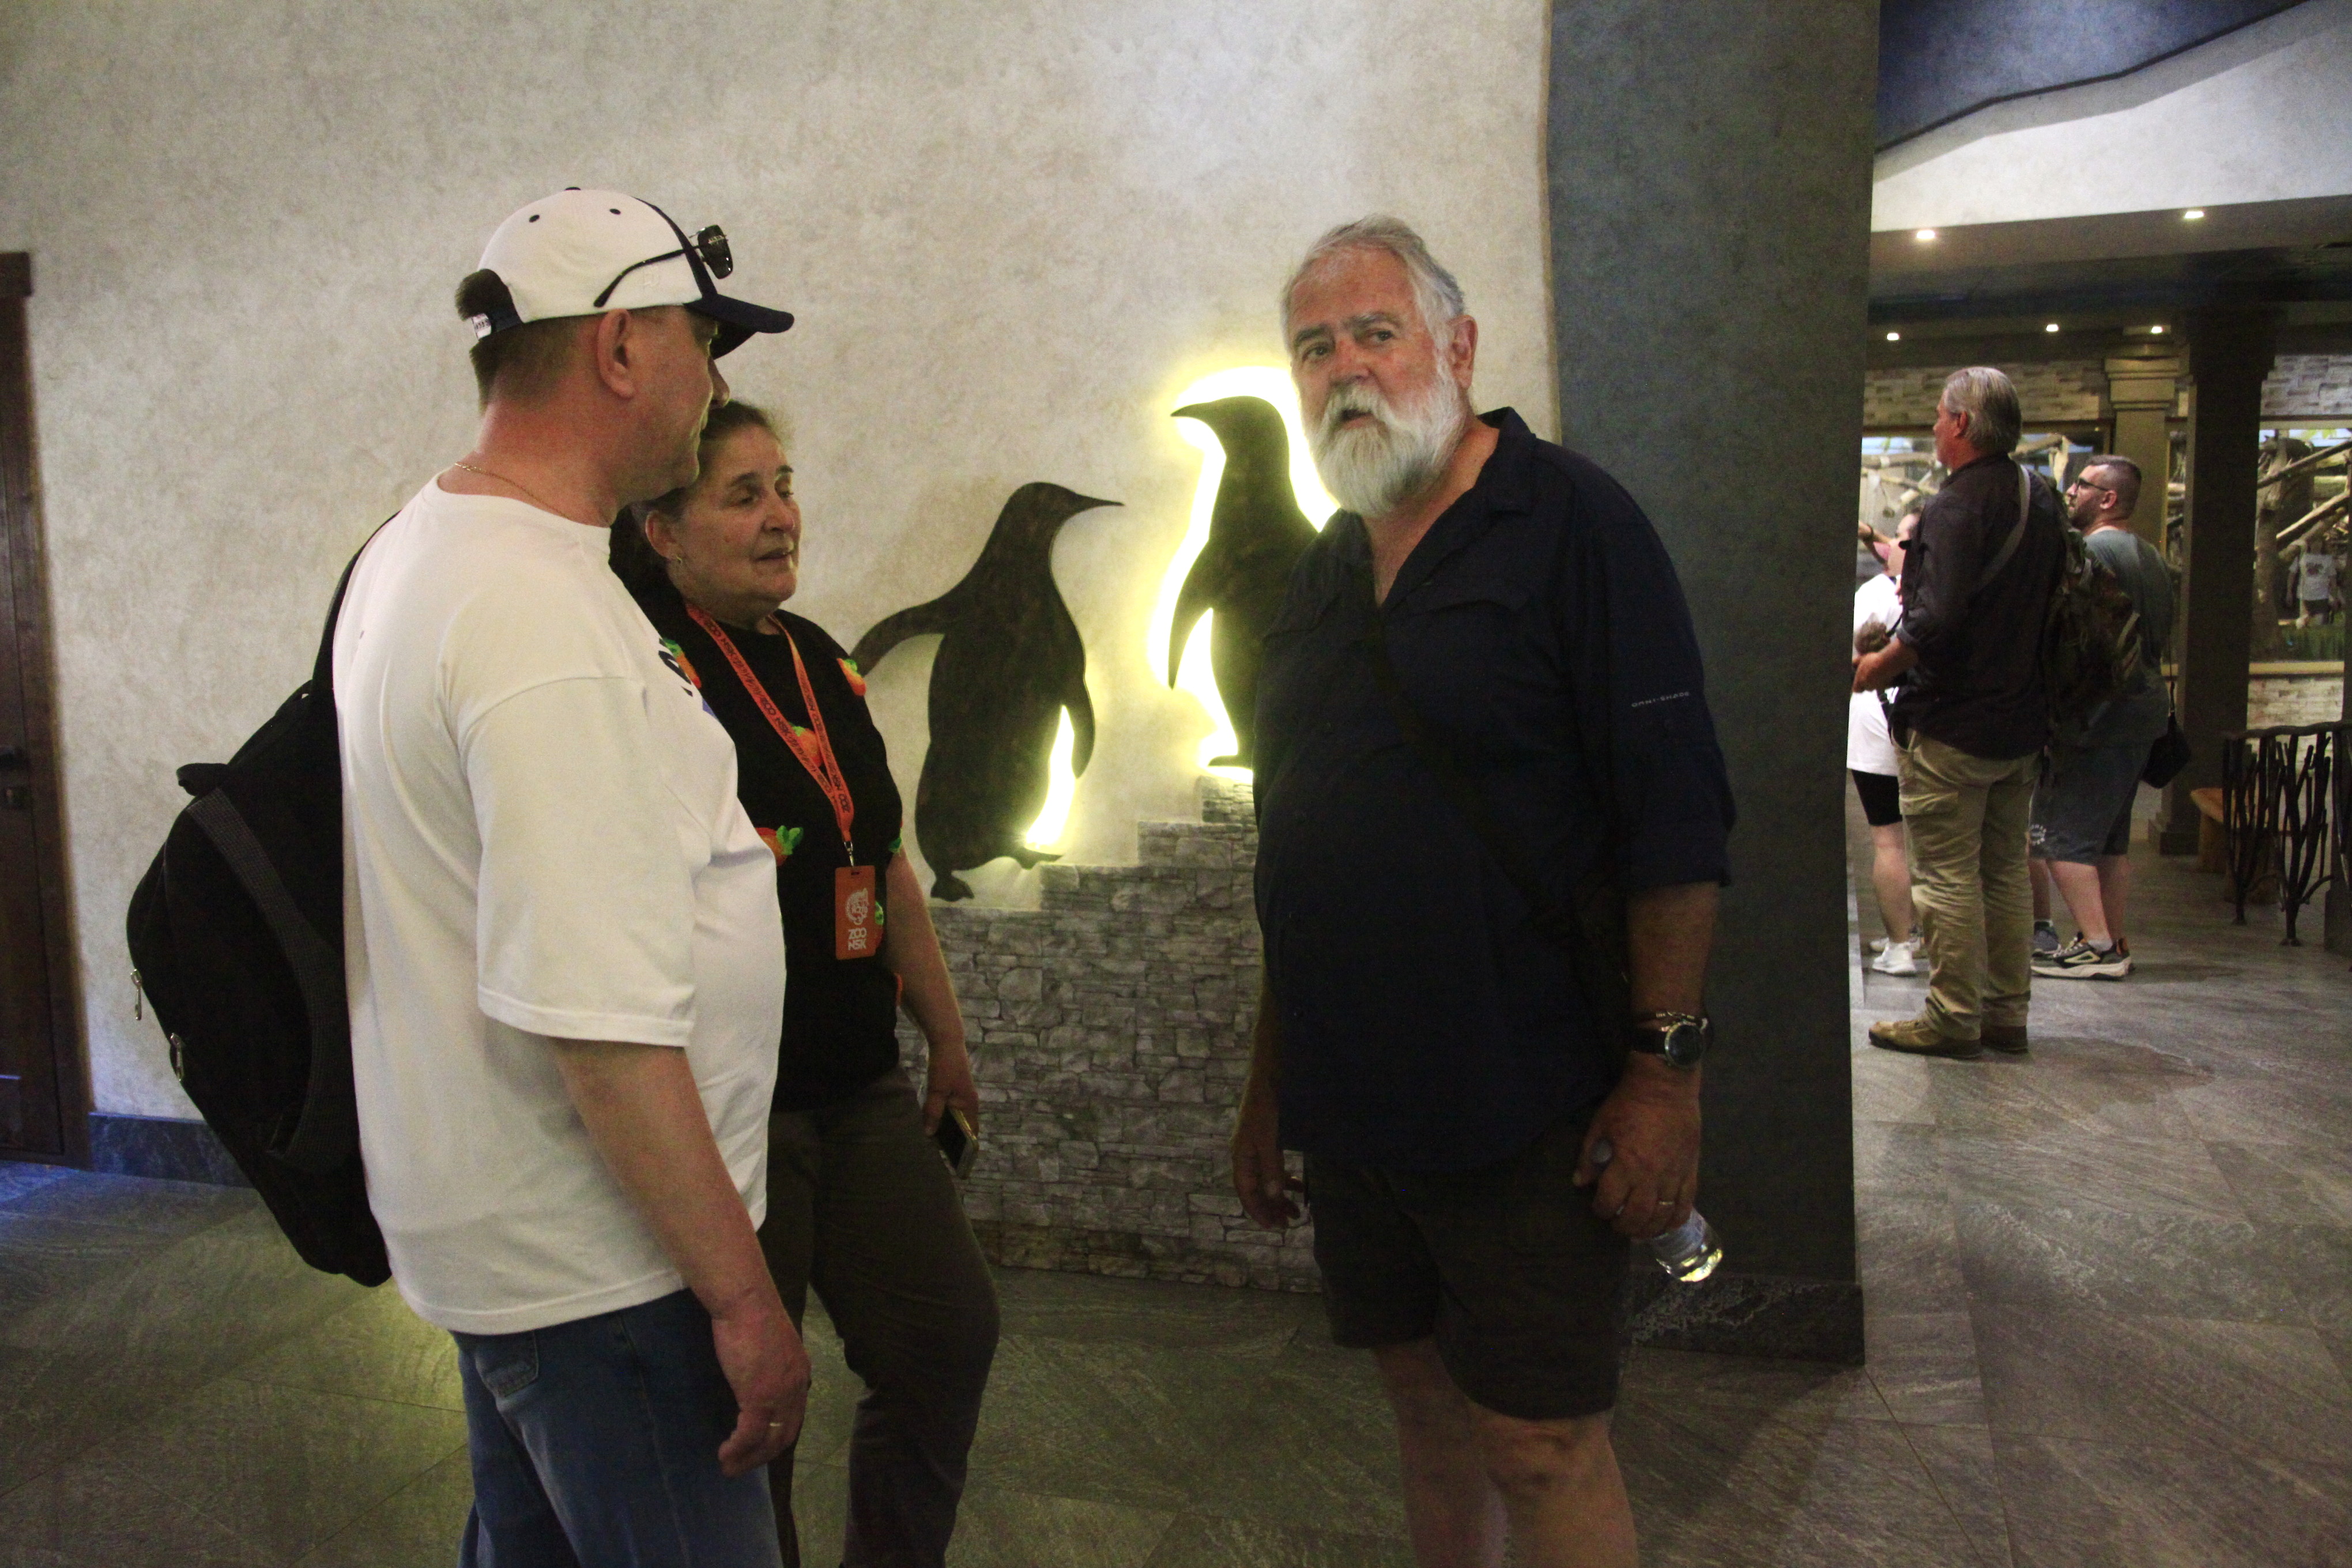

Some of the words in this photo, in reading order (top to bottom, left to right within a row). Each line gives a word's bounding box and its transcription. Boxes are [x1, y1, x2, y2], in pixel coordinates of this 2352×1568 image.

[1631, 691, 1690, 707] OMNI-SHADE
[838, 793, 850, 813] ZOO
[848, 927, 867, 940] ZOO
[848, 938, 866, 951] NSK
